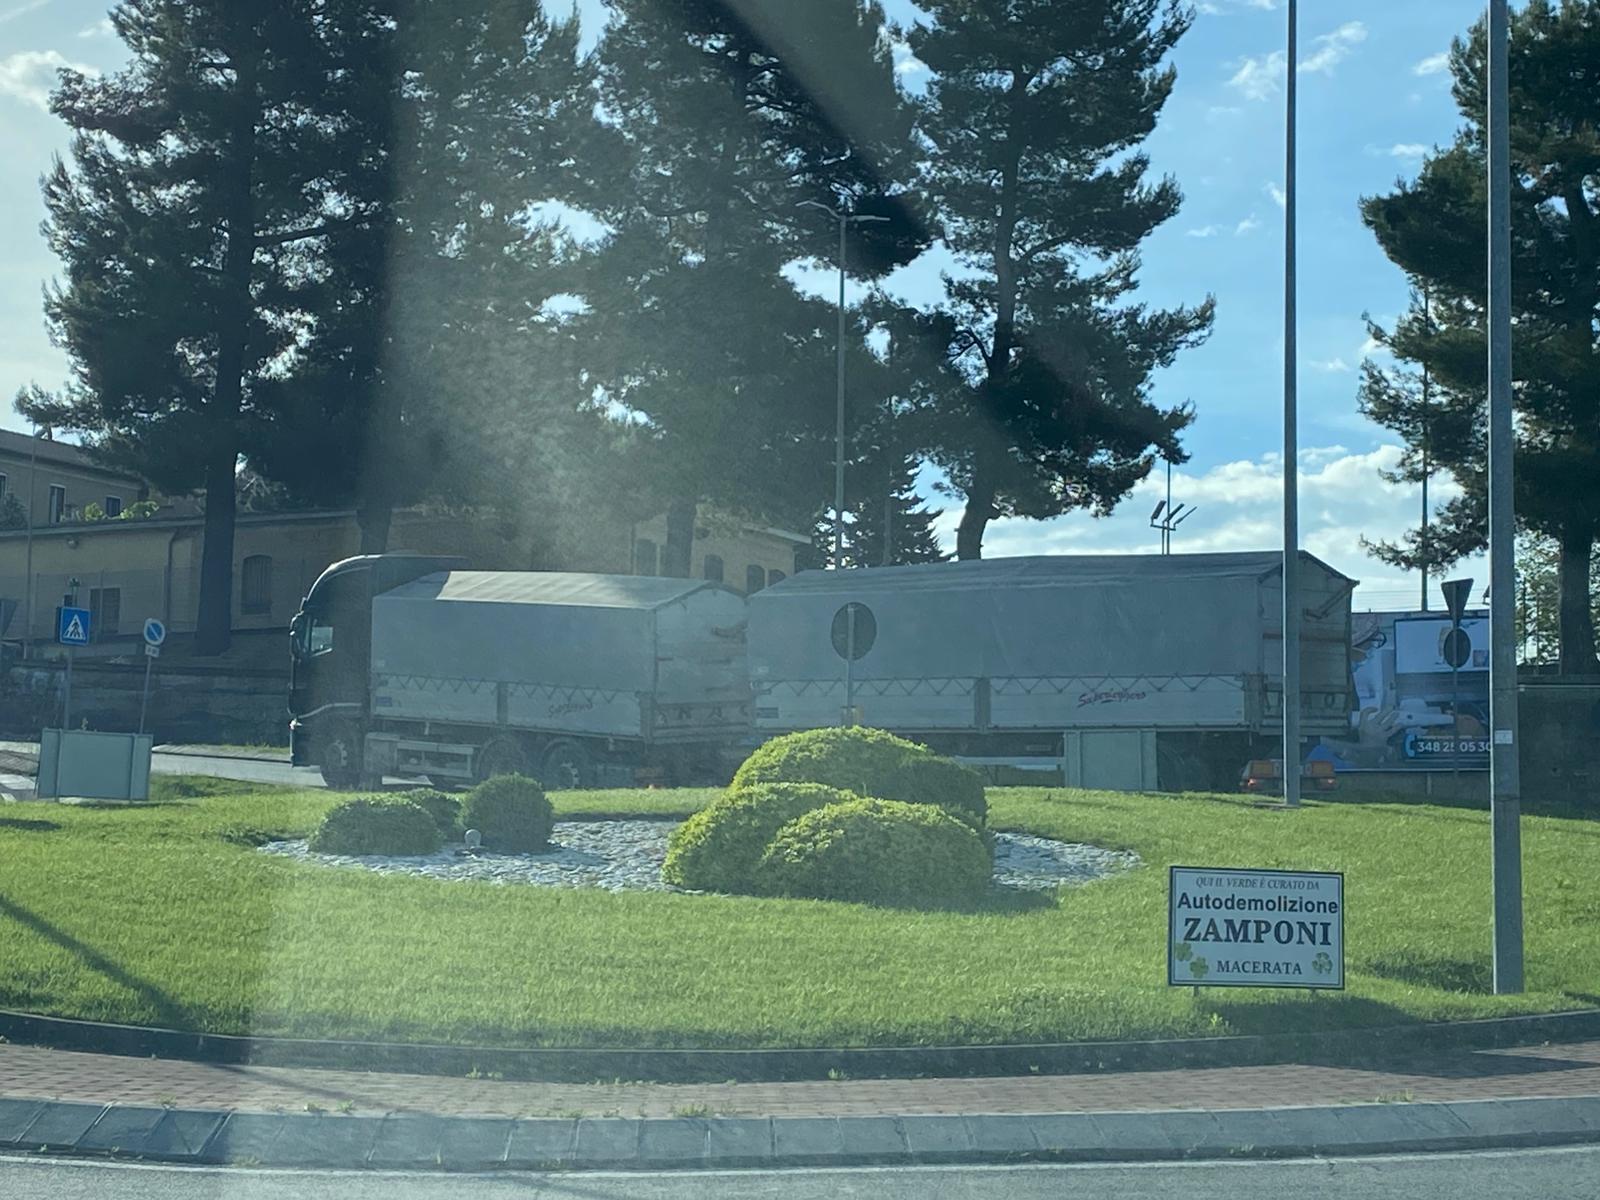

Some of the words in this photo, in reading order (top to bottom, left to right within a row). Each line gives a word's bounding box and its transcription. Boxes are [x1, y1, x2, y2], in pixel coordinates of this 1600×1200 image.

[1417, 741, 1440, 752] 348
[1460, 741, 1476, 752] 05
[1196, 877, 1214, 888] QUI
[1215, 878, 1224, 888] IL
[1226, 878, 1258, 888] VERDE
[1267, 879, 1305, 890] CURATO
[1306, 881, 1320, 890] DA
[1177, 892, 1338, 913] Autodemolizione
[1183, 918, 1332, 945] ZAMPONI
[1216, 960, 1303, 975] MACERATA
